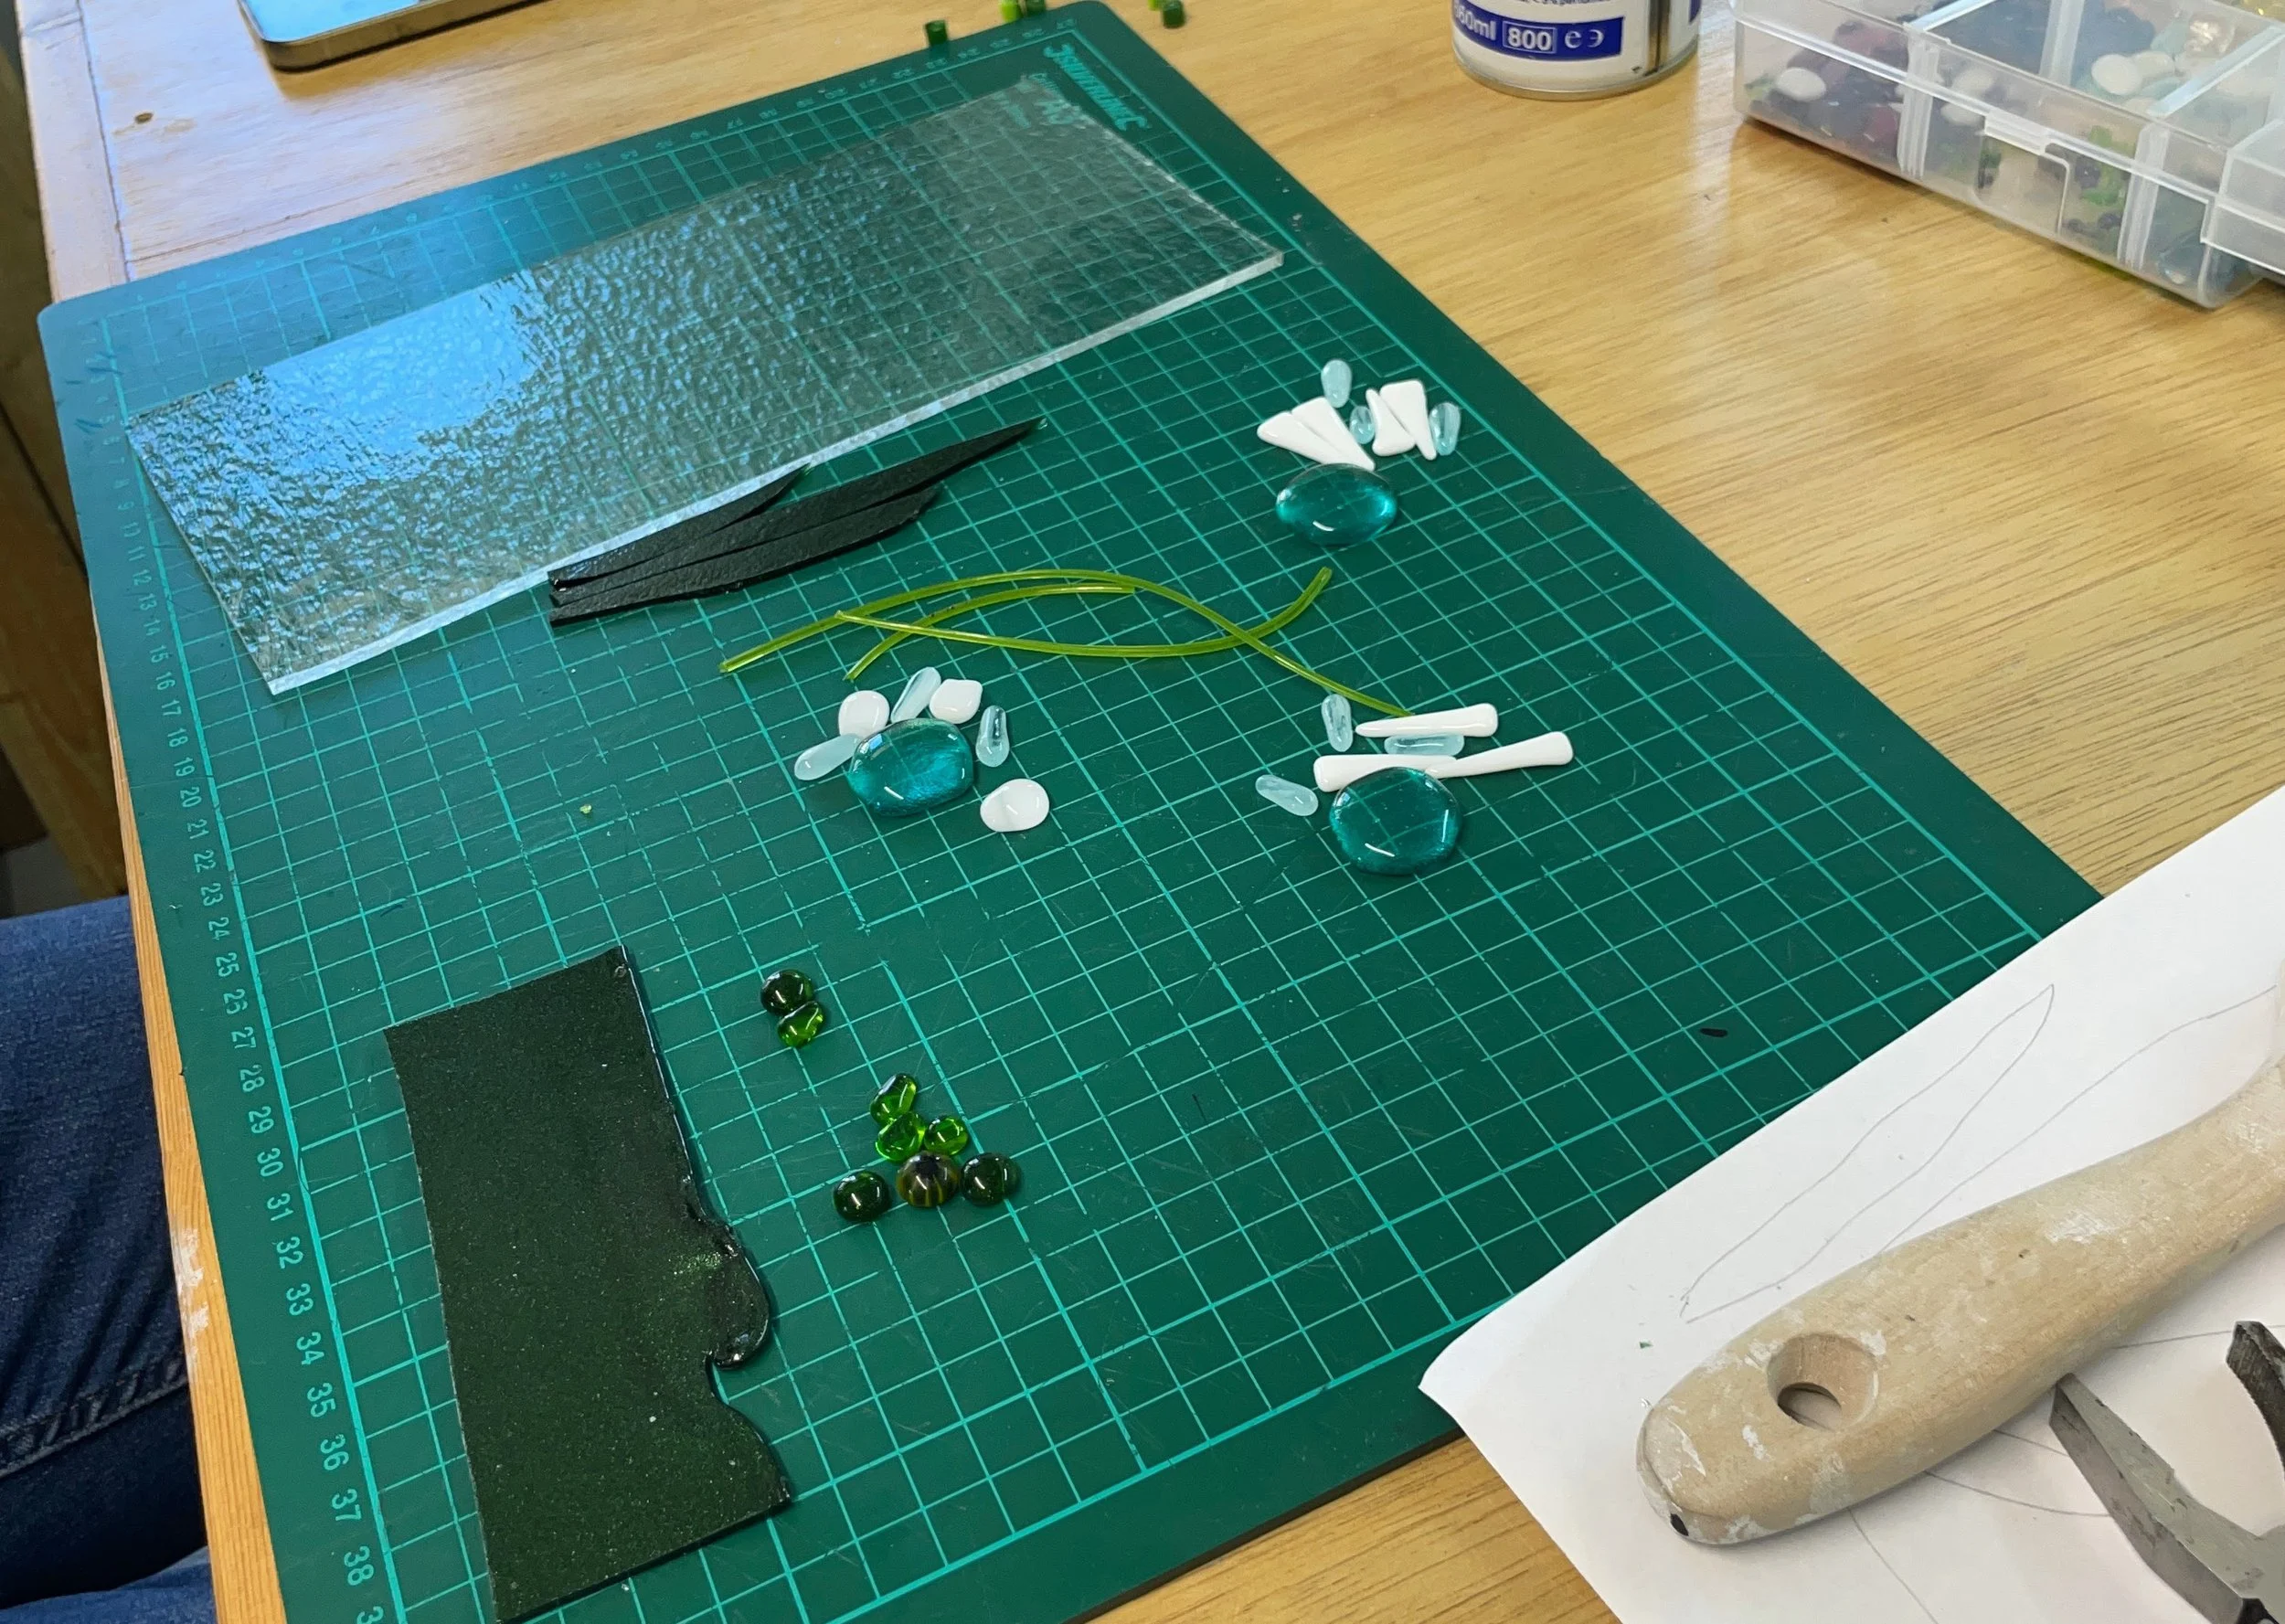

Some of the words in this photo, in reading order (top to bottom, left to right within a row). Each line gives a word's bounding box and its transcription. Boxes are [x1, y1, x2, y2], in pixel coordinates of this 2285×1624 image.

[1507, 27, 1552, 51] 800
[128, 546, 147, 562] 11
[133, 568, 152, 586] 12
[139, 593, 157, 611] 13
[143, 619, 162, 636] 14
[150, 644, 168, 663] 15
[155, 672, 175, 691] 16
[161, 699, 182, 716] 17
[167, 727, 188, 748] 18
[174, 757, 196, 777] 19
[180, 786, 202, 808] 20
[186, 819, 209, 839] 21
[194, 849, 217, 873] 22
[200, 882, 224, 907] 23
[207, 917, 230, 940] 24
[216, 952, 239, 978] 25
[231, 1026, 257, 1049] 27
[239, 1064, 265, 1093] 28
[248, 1106, 274, 1134] 29
[257, 1147, 283, 1177] 30
[266, 1193, 294, 1221] 31
[276, 1237, 303, 1269] 32
[285, 1283, 314, 1316] 33
[296, 1332, 324, 1365] 34
[306, 1382, 335, 1417] 35
[320, 1433, 349, 1470] 36
[331, 1488, 362, 1522] 37
[344, 1545, 375, 1587] 38
